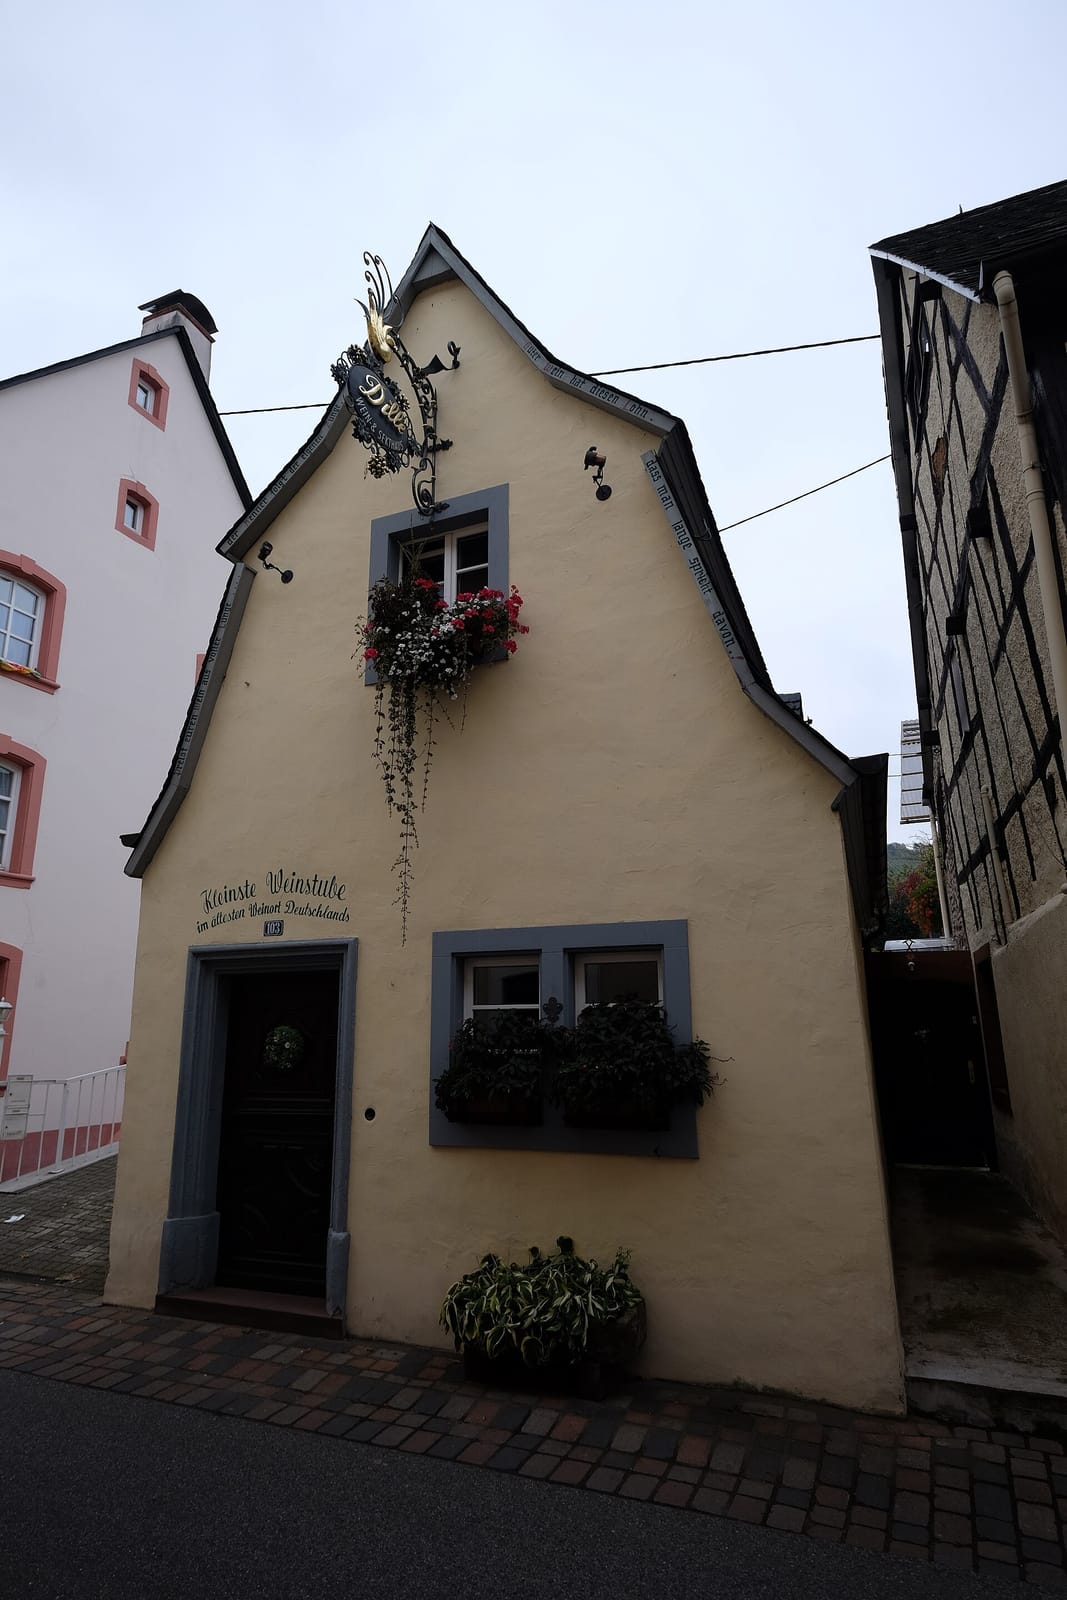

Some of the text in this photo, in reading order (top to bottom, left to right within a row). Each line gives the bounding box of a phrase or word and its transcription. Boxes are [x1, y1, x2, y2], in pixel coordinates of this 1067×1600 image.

[569, 375, 586, 389] hat
[589, 384, 620, 405] diesen
[646, 458, 662, 482] dass
[656, 483, 674, 511] man
[671, 519, 693, 551] lange
[688, 556, 714, 596] spricht
[200, 868, 346, 914] Kleinste Weinstube
[196, 900, 351, 934] im ältesten Weinort Deutschlands
[265, 921, 281, 935] 103
